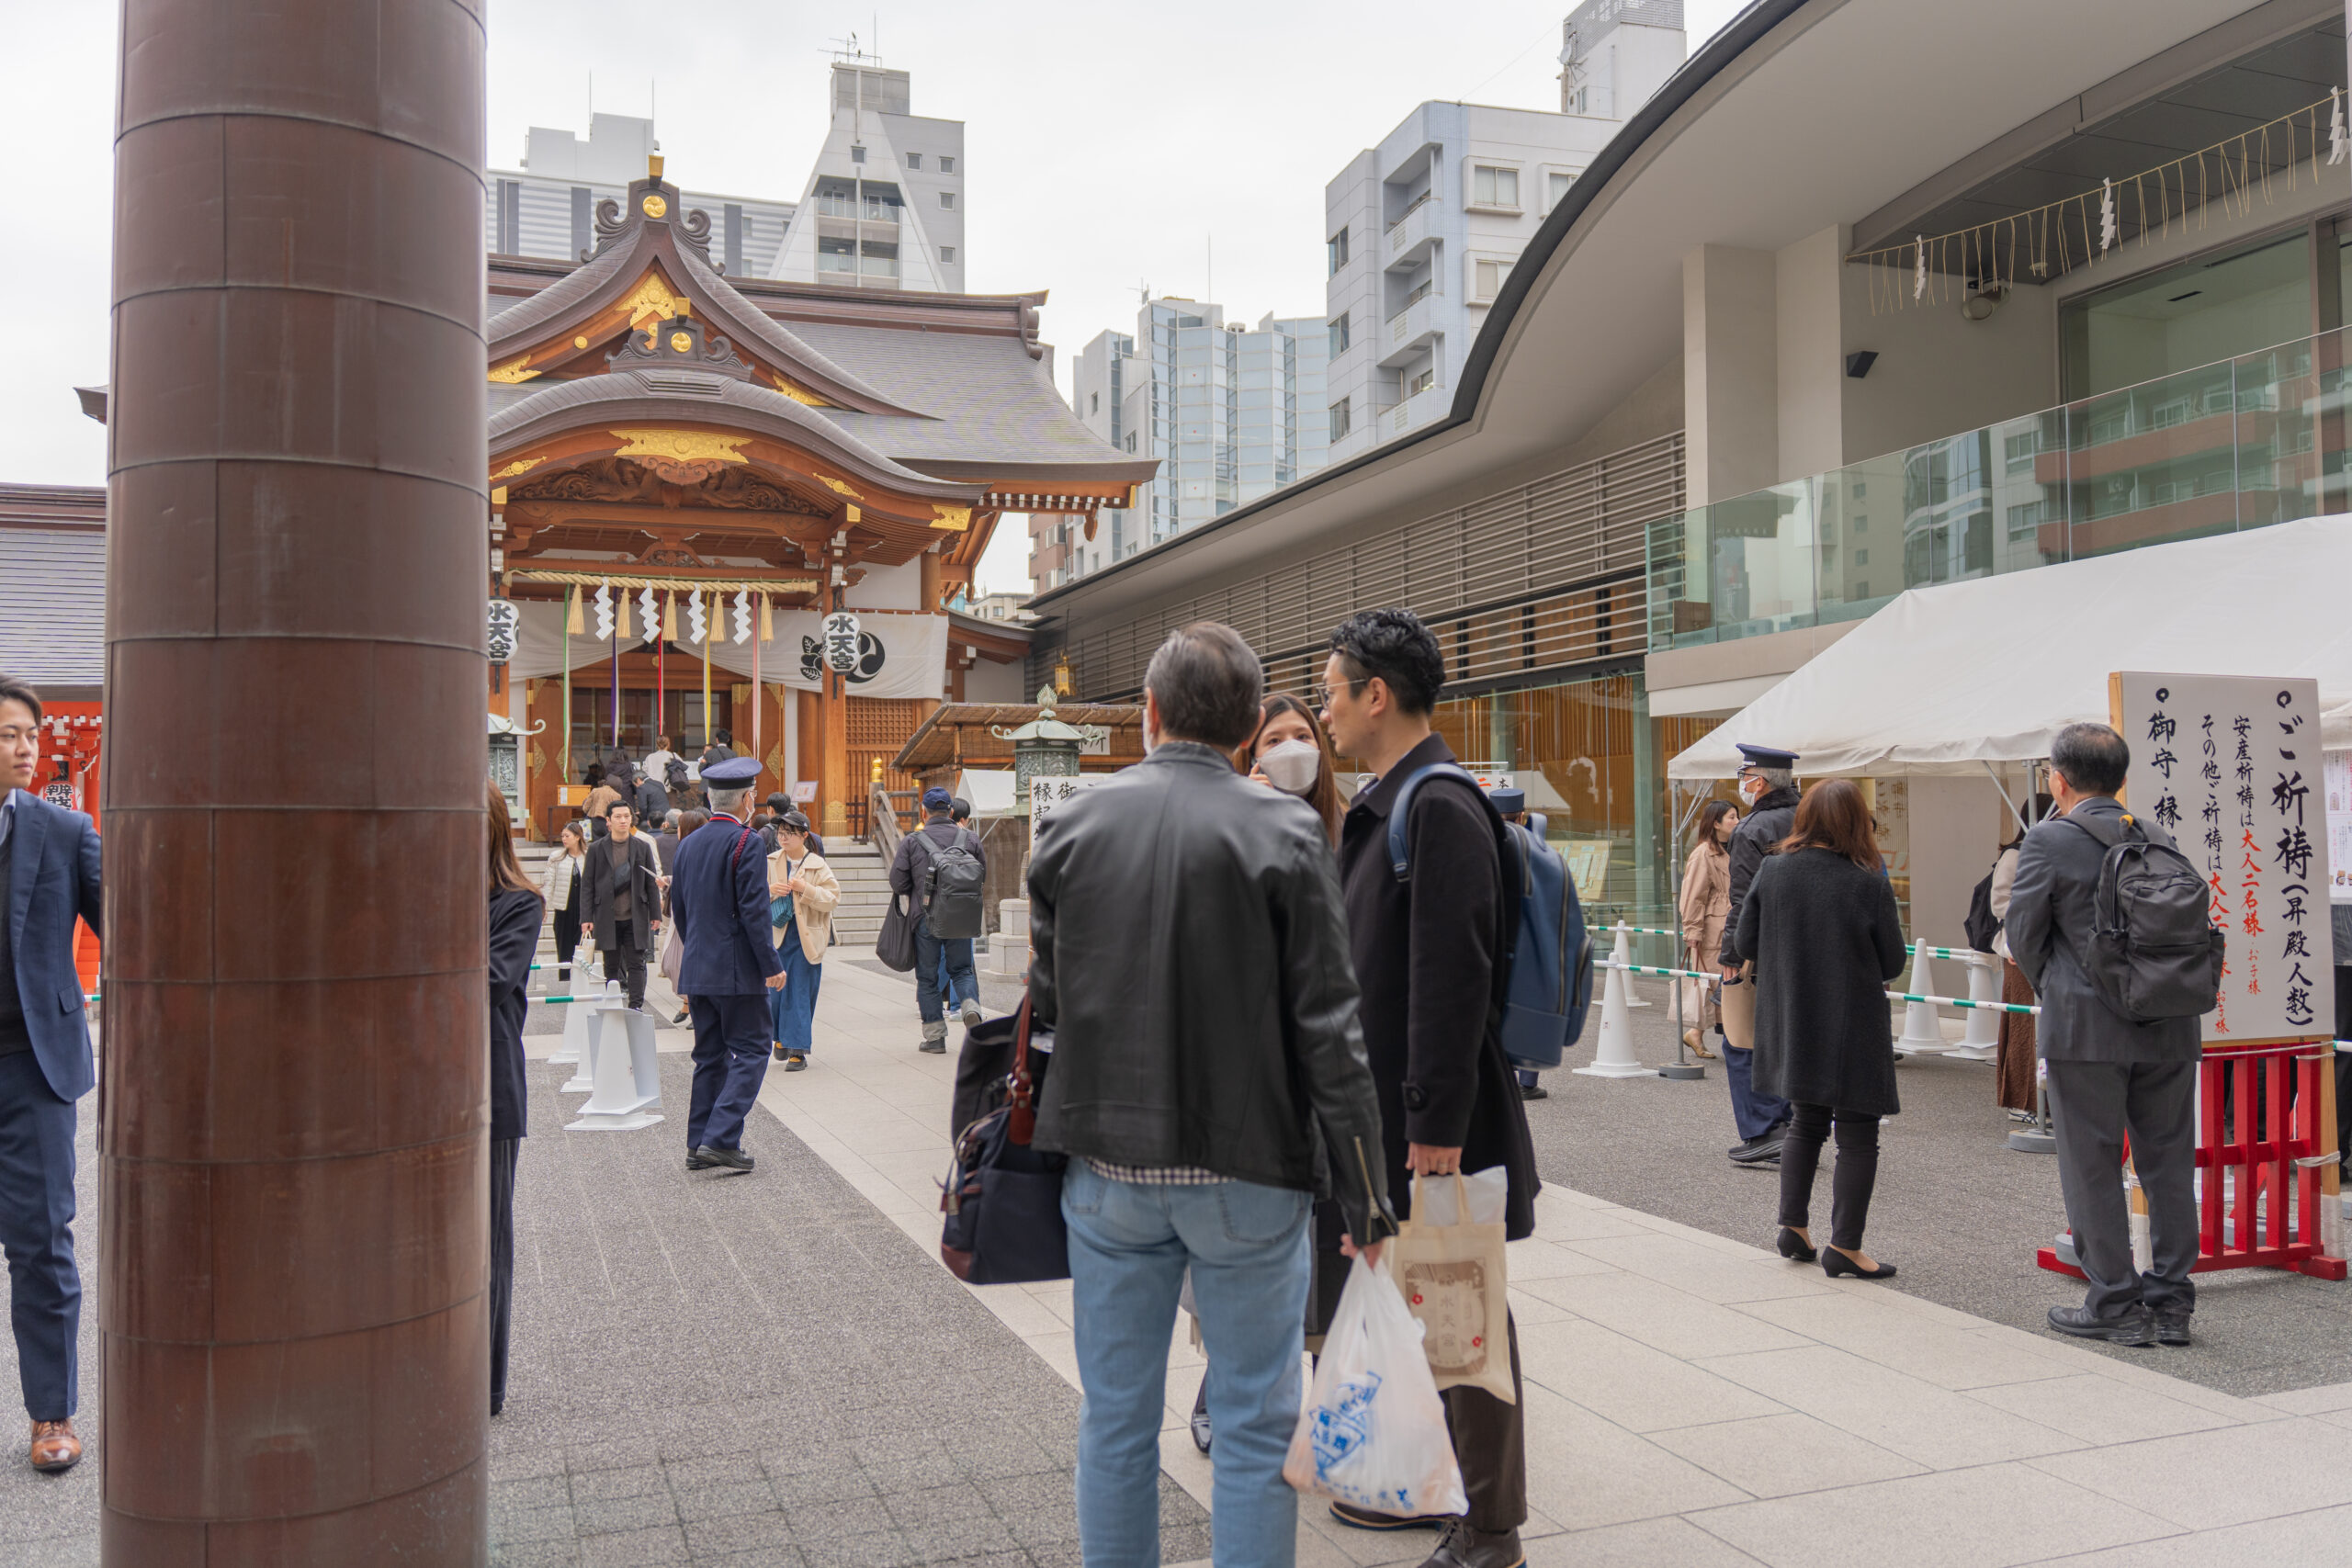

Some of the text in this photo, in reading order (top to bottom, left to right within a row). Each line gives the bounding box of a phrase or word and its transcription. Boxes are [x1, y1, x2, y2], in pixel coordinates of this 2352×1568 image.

[488, 603, 513, 660] 水天宮
[828, 615, 855, 670] 水天宮
